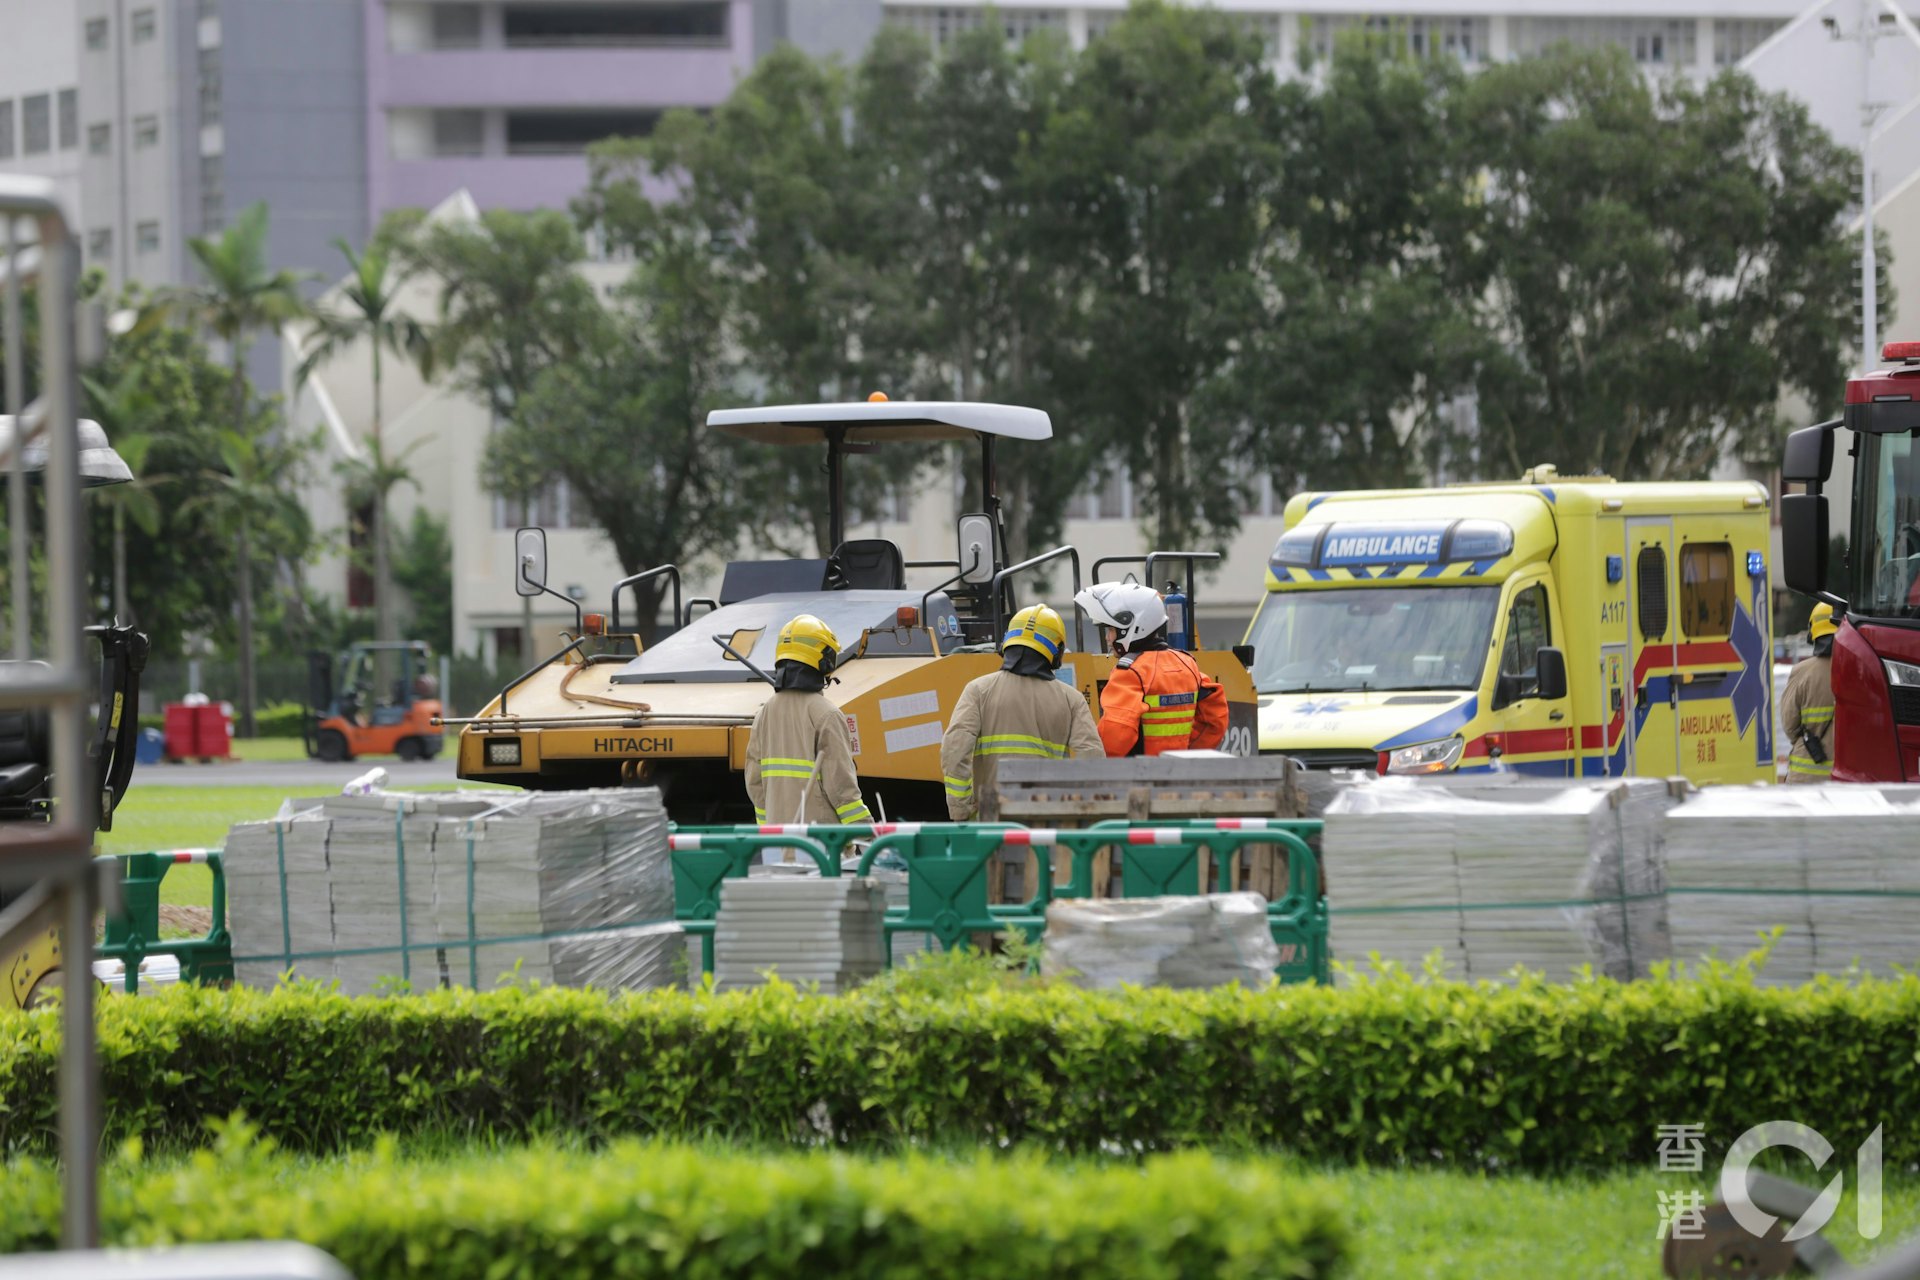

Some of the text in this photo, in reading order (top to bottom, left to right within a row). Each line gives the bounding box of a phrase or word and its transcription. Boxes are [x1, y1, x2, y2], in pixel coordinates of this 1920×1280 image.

[1325, 535, 1440, 558] AMBULANCE
[1600, 601, 1625, 624] A117
[1680, 714, 1732, 736] AMBULANCE
[594, 737, 673, 752] HITACHI
